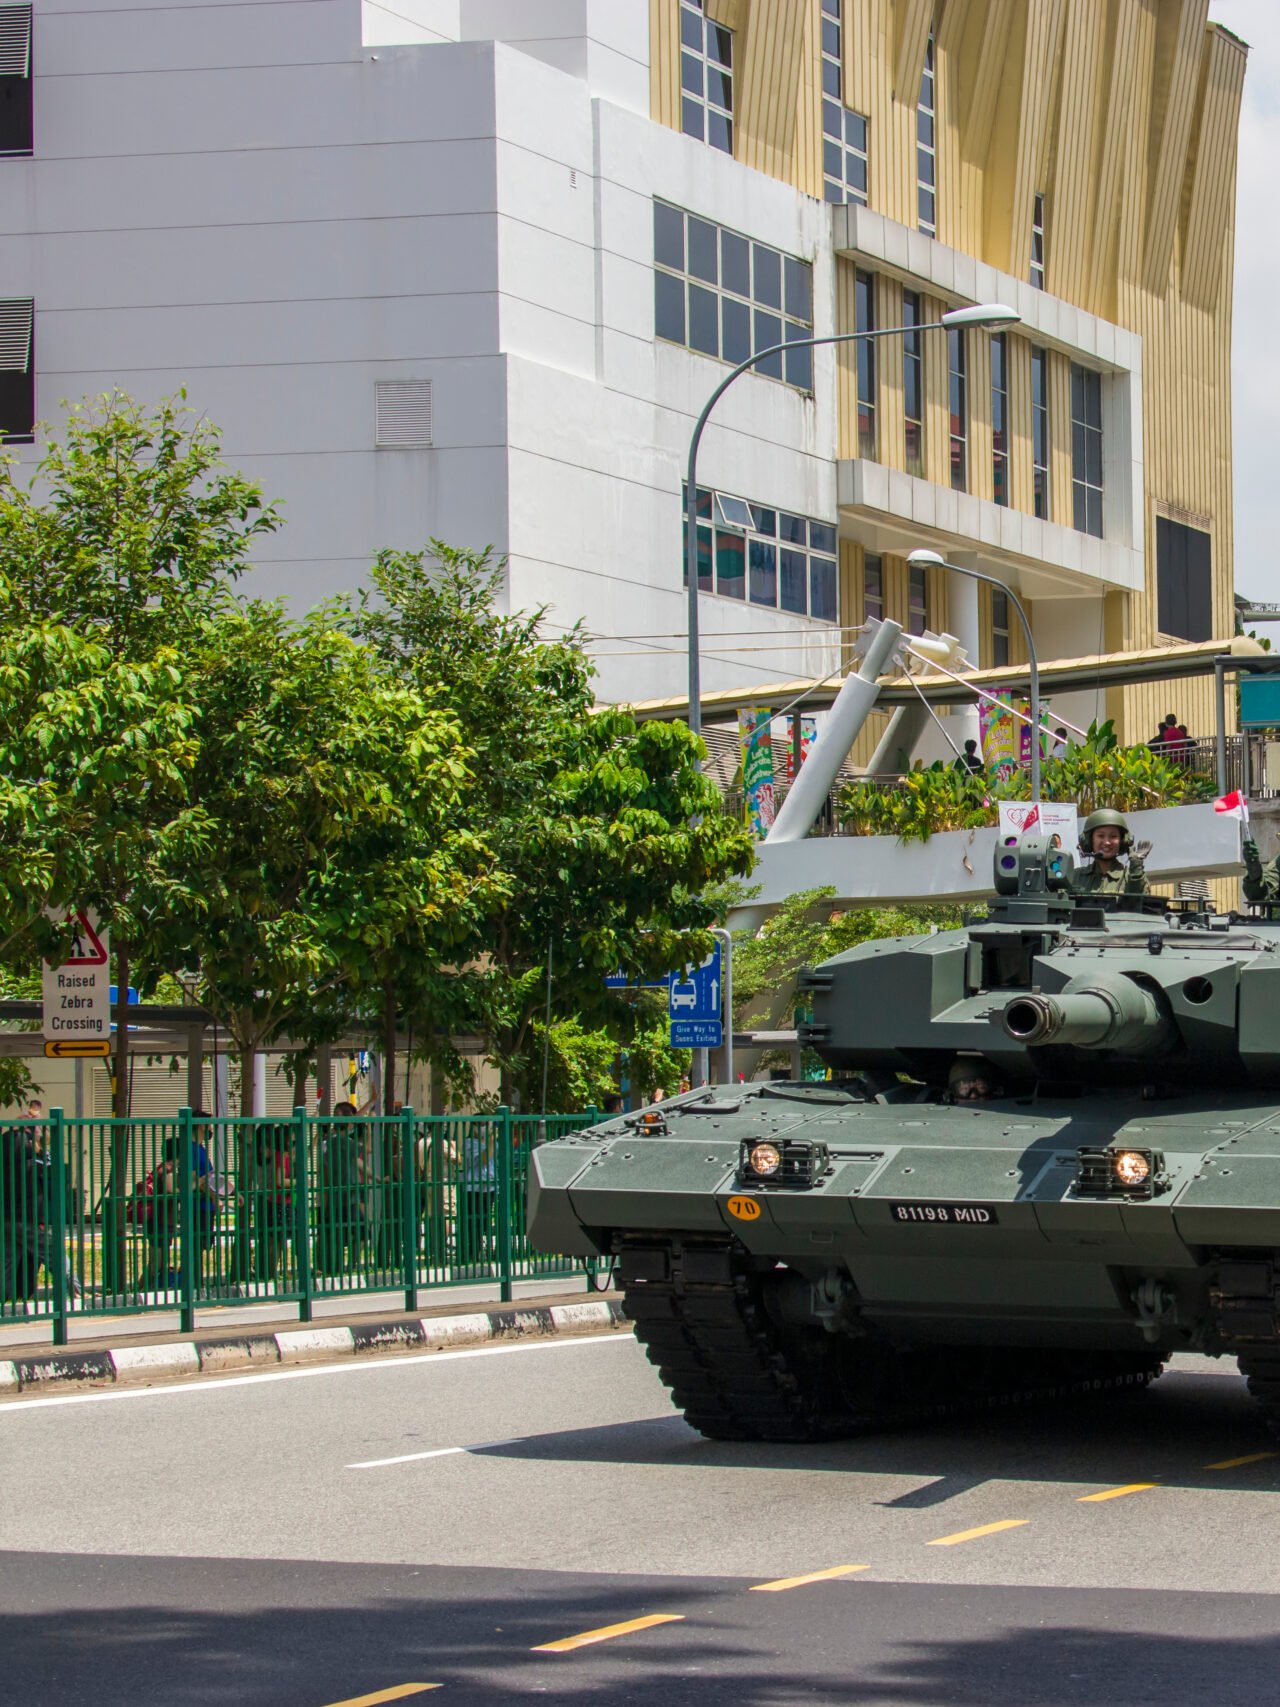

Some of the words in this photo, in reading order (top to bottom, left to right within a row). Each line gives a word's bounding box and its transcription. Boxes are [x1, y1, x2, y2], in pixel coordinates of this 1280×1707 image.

[751, 747, 769, 761] Let's
[57, 973, 96, 988] Raised
[61, 995, 94, 1008] Zebra
[52, 1016, 103, 1032] Crossing
[676, 1025, 691, 1033] Give
[693, 1025, 706, 1035] Way
[708, 1025, 716, 1033] to
[696, 1034, 718, 1043] Exiting
[732, 1201, 756, 1214] 70
[897, 1206, 948, 1221] 81198
[954, 1208, 990, 1222] MID
